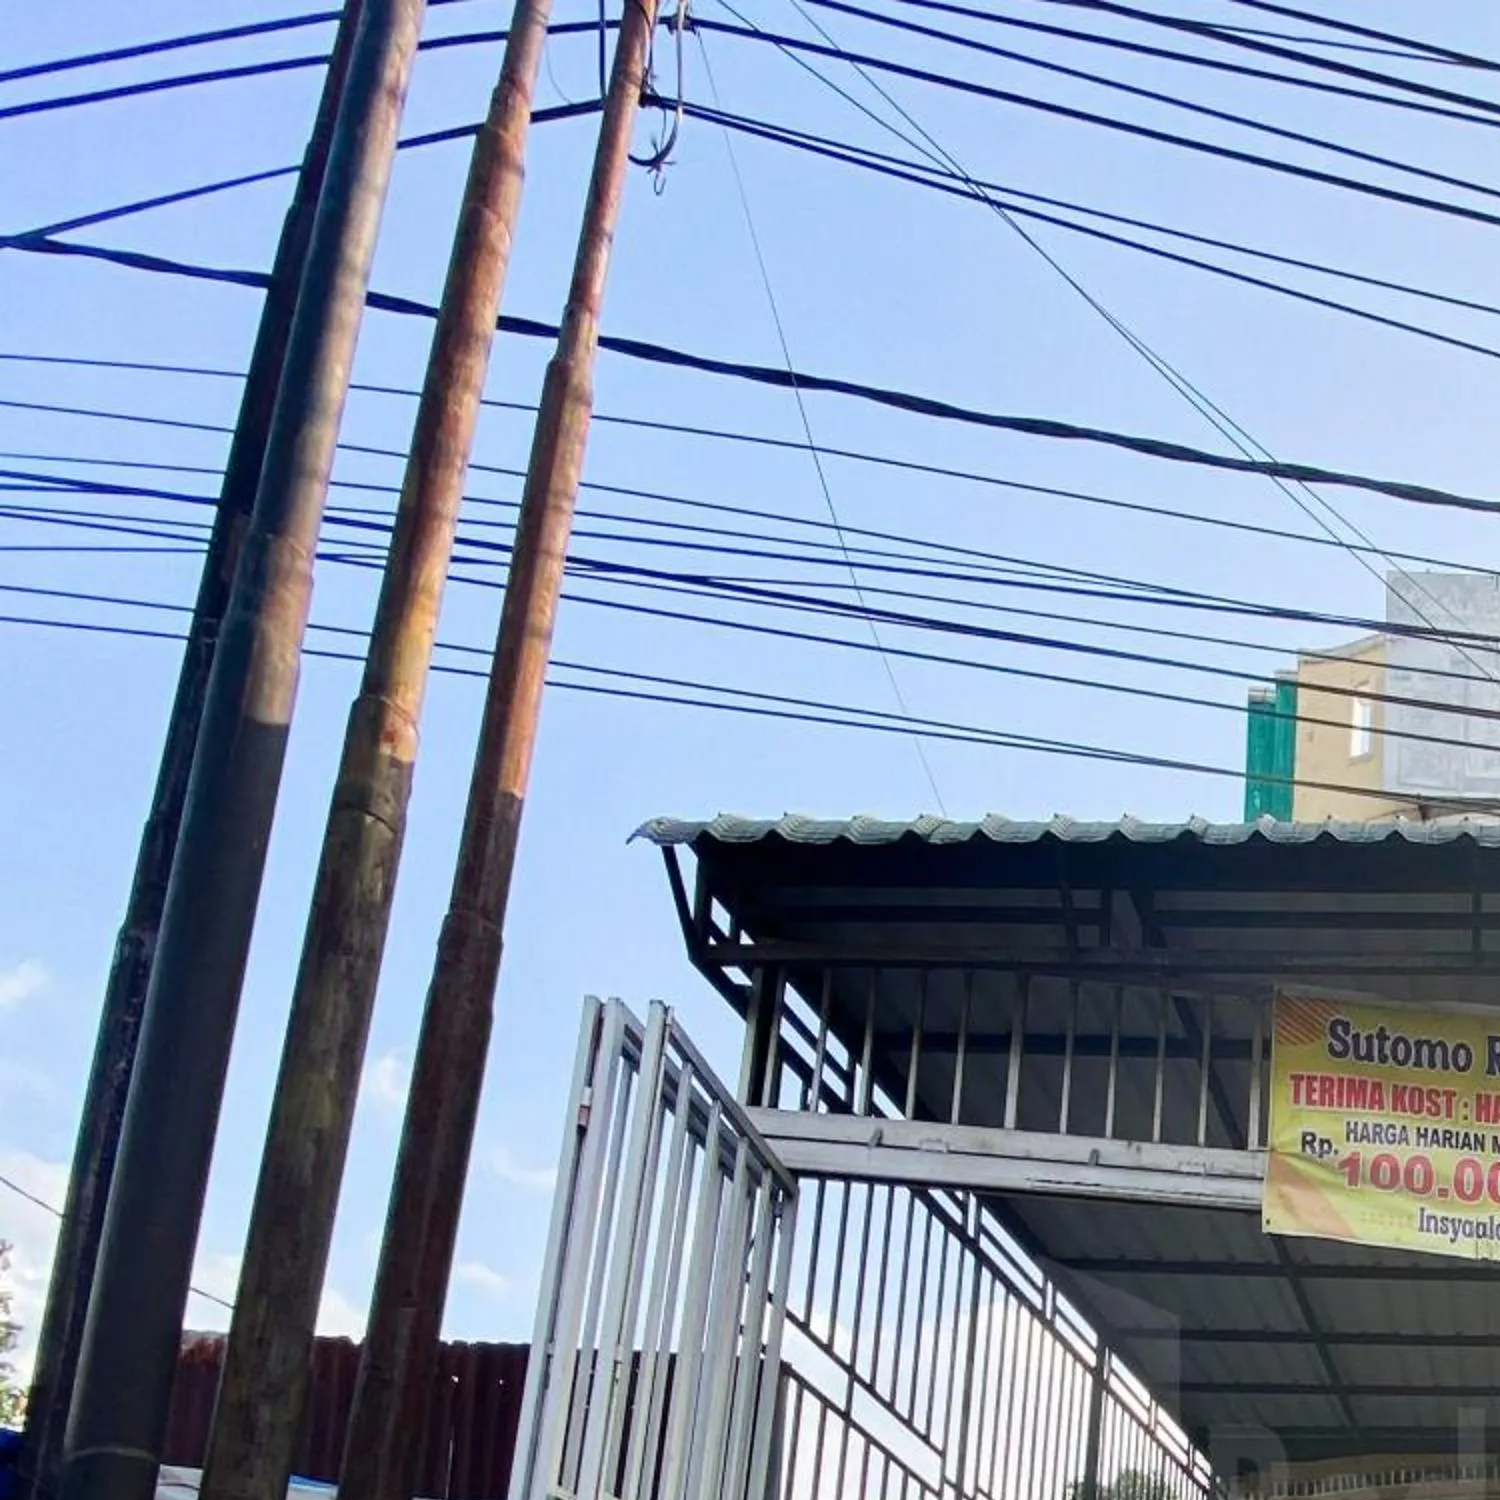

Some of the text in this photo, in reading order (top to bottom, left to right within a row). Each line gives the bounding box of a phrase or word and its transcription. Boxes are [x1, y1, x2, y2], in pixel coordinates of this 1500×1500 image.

[1327, 1018, 1474, 1073] Sutomo
[1289, 1074, 1385, 1111] TERIMA
[1391, 1084, 1457, 1119] KOST
[1301, 1131, 1338, 1158] Rp.
[1345, 1121, 1409, 1147] HARGA
[1416, 1127, 1485, 1153] HARIAN
